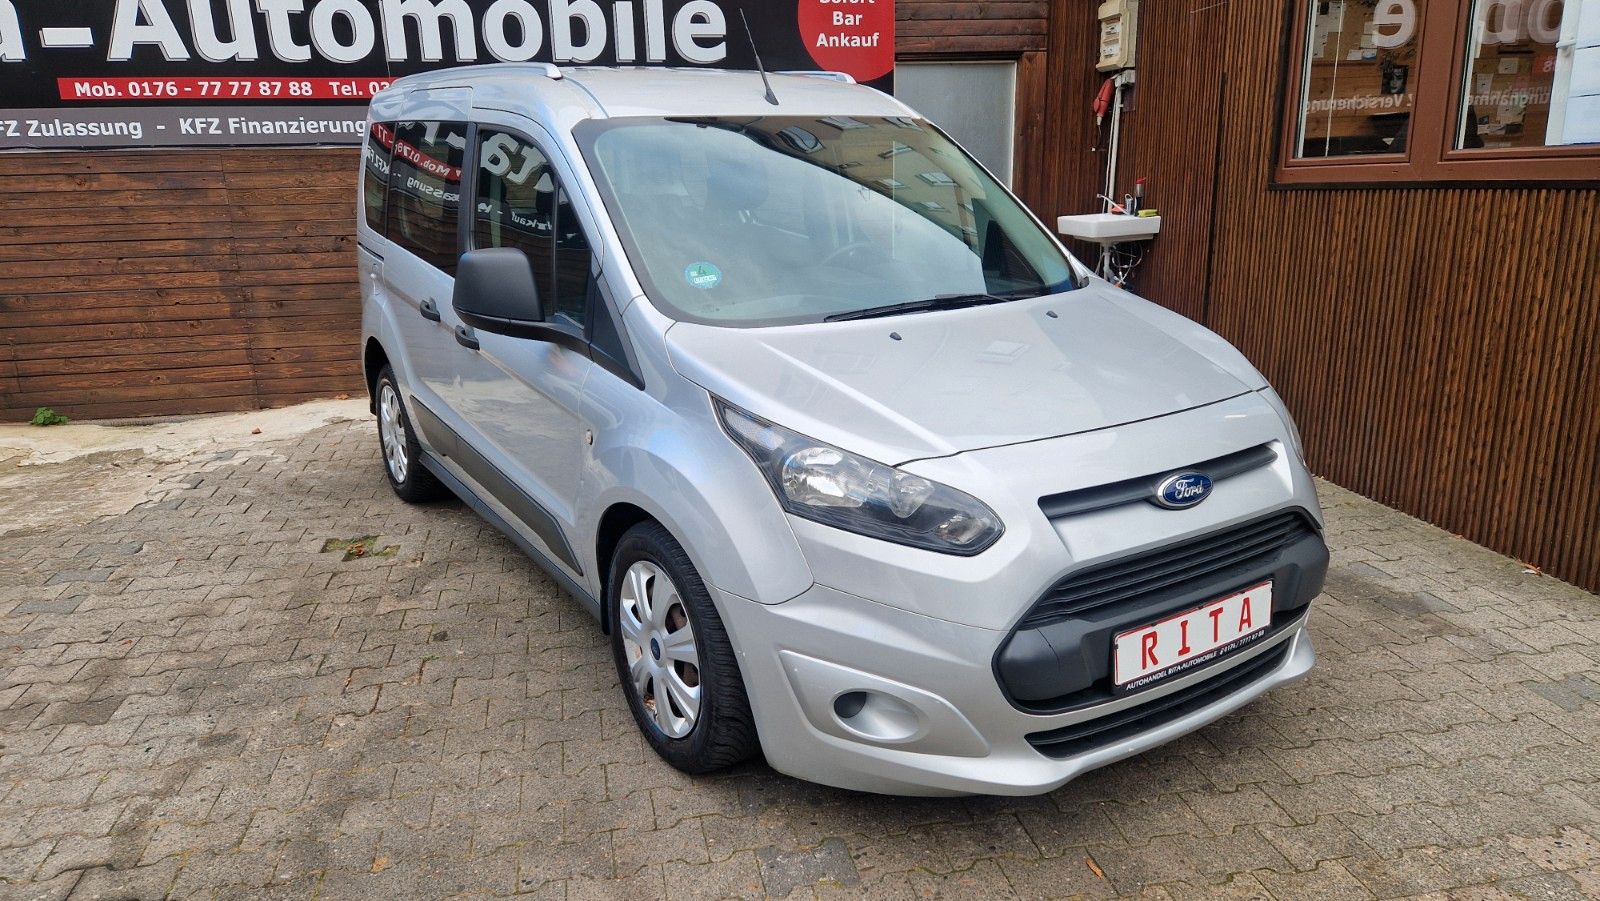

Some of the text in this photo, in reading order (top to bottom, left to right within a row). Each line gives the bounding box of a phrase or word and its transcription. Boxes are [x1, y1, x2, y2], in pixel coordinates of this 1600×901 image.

[832, 10, 863, 26] Bar
[816, 32, 880, 47] Ankauf
[74, 81, 122, 97] Mob.
[128, 81, 178, 96] 0176
[198, 81, 221, 96] 77
[228, 81, 252, 96] 77
[258, 81, 282, 96] 87
[288, 81, 313, 96] 88
[329, 81, 363, 96] Tel.
[26, 118, 143, 139] Zulassung
[179, 117, 222, 135] KFZ
[228, 116, 365, 137] Finanzierung
[1175, 478, 1204, 499] Ford
[1126, 671, 1168, 690] AUTOHANDEL
